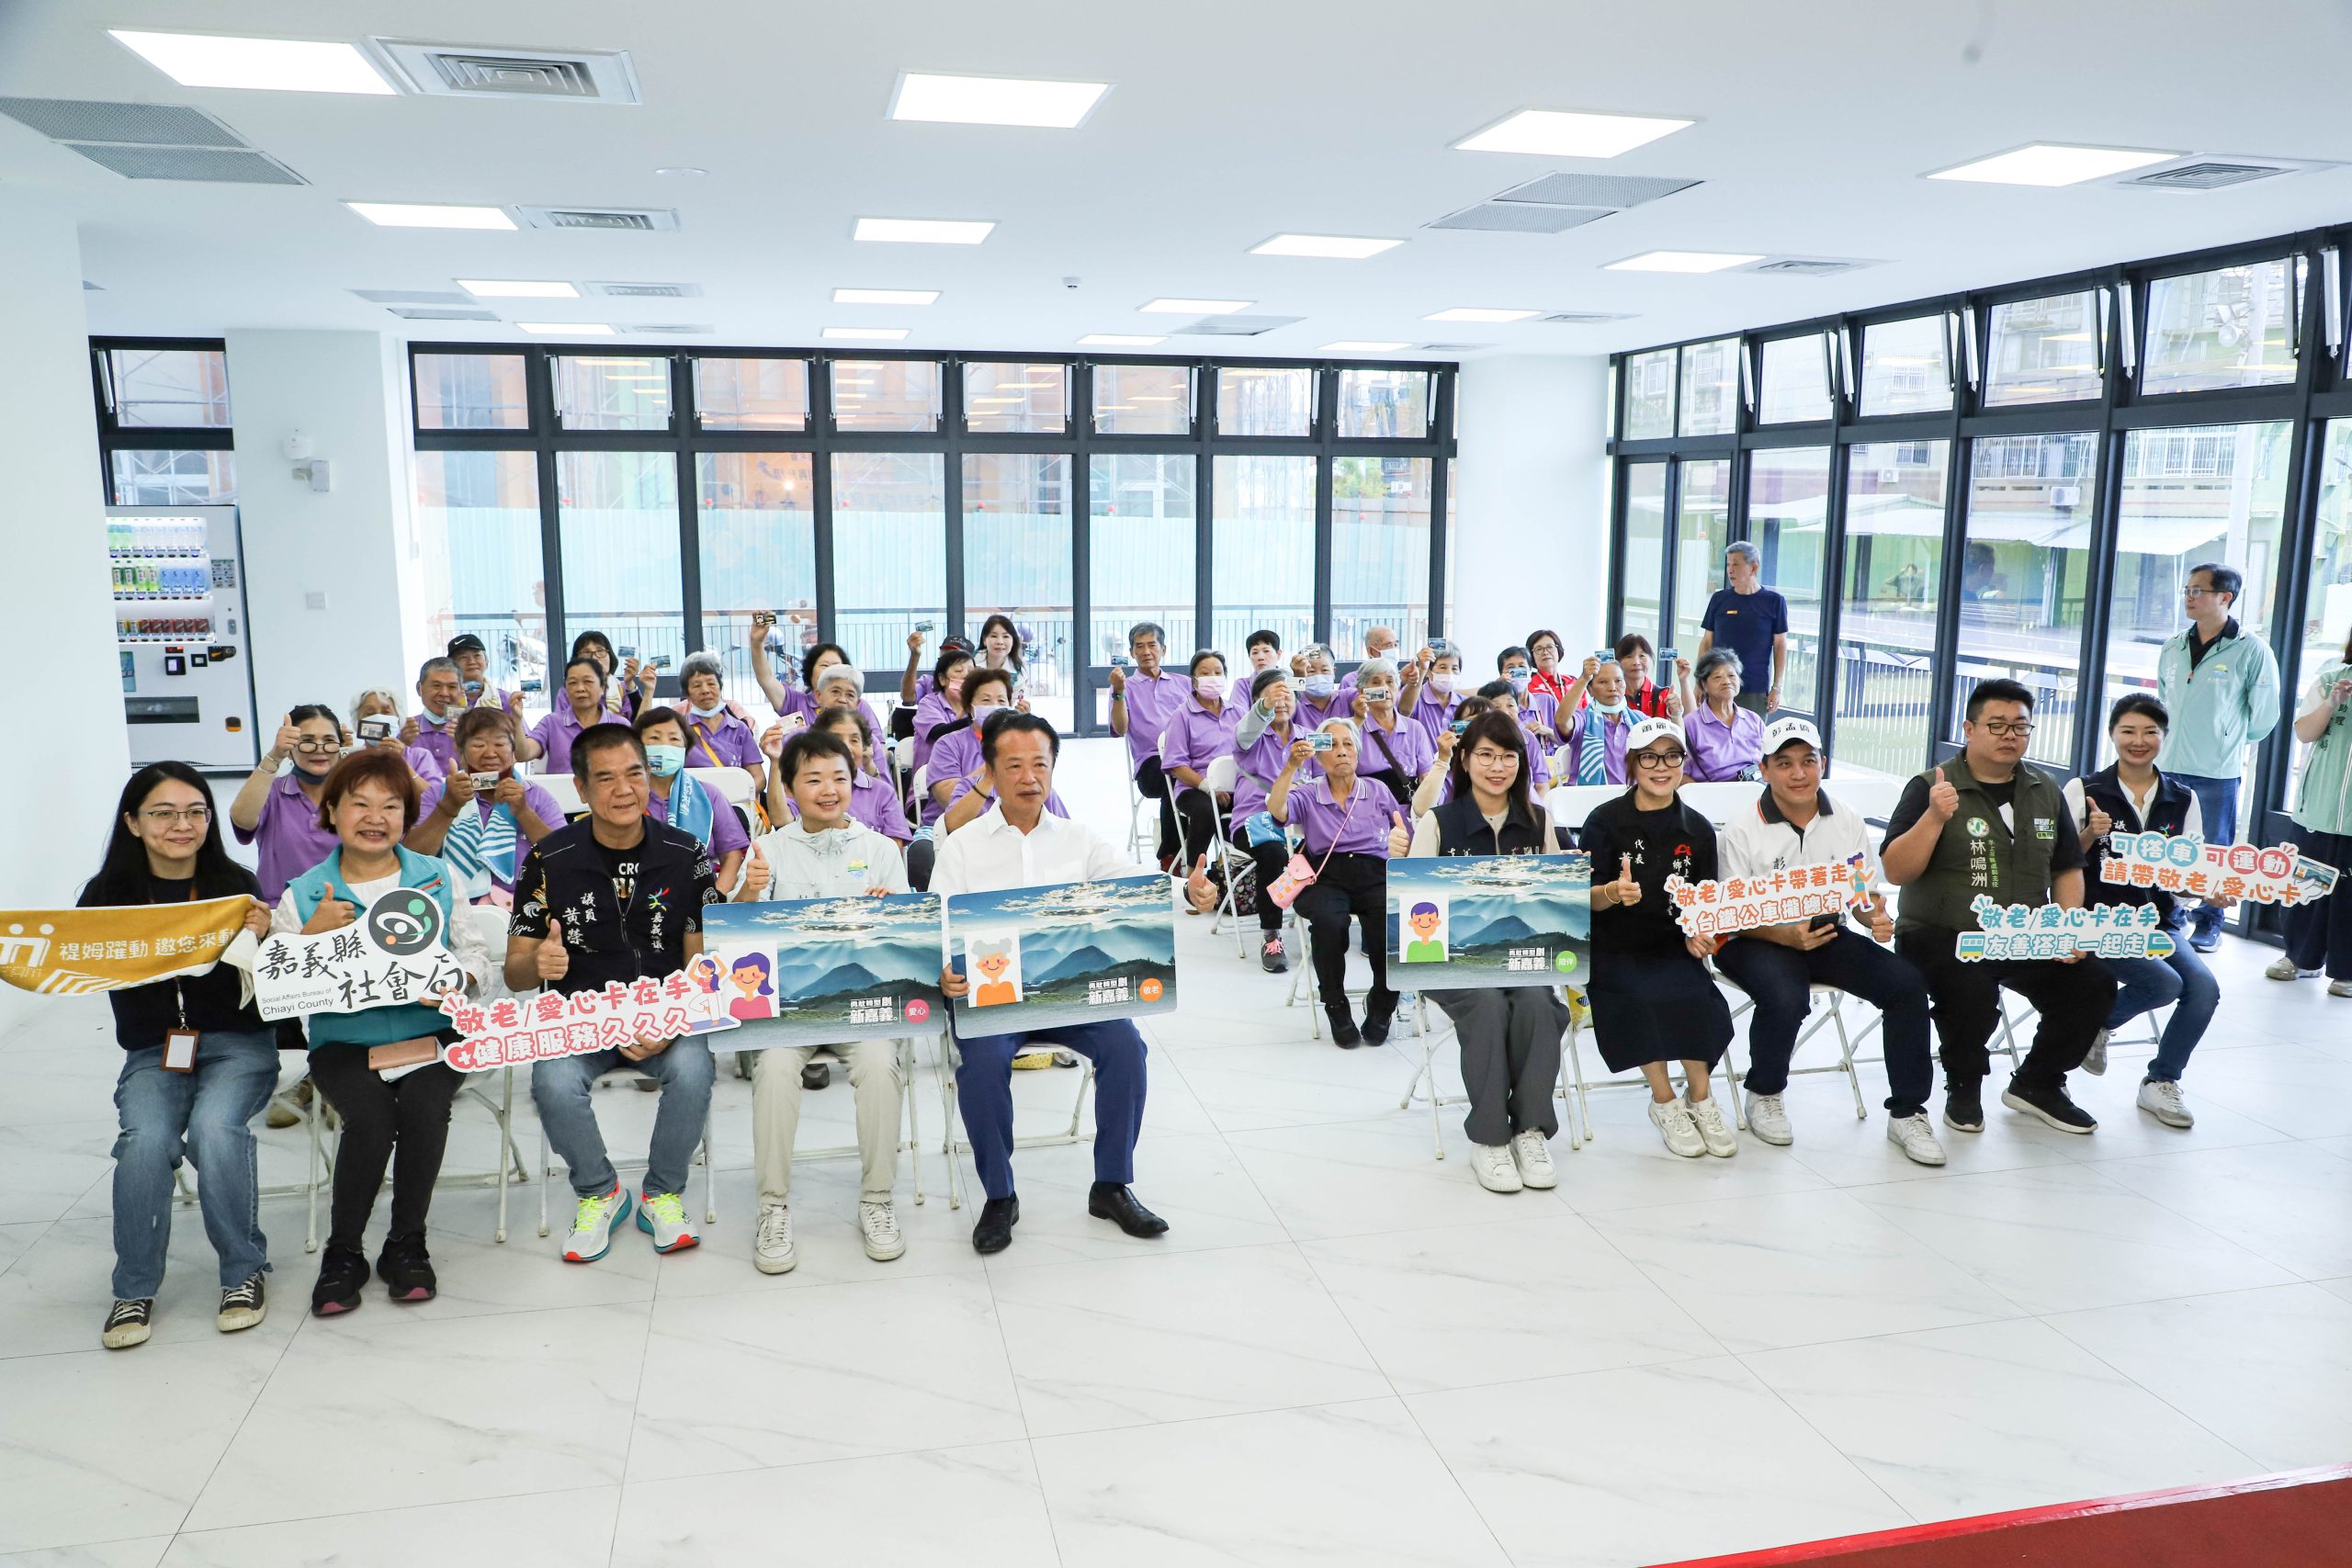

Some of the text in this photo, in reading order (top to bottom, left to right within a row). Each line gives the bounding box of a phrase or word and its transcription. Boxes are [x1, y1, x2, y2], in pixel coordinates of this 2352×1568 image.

[1634, 839, 1645, 864] 代表
[1970, 839, 1987, 887] 林鳴洲
[2113, 833, 2288, 875] 可搭車 可運動
[1676, 863, 1849, 908] 敬老/愛心卡帶著走
[2103, 861, 2301, 905] 請帶敬老/愛心卡
[581, 892, 597, 922] 議員
[1697, 890, 1842, 933] 台鐵公車攏總有
[1981, 906, 2158, 930] 敬老/愛心卡在手
[257, 929, 368, 980] 嘉義縣
[1558, 957, 1574, 966] 陪伴
[1985, 932, 2145, 957] 友善搭車一起走
[262, 995, 281, 1004] Social
[282, 992, 301, 1001] Affairs
[302, 989, 324, 998] Bureau
[337, 953, 464, 1010] 社會局
[1143, 986, 1160, 995] 敬老
[263, 998, 334, 1016] Chiayi County
[456, 974, 692, 1034] 敬老/愛心卡在手
[909, 1007, 926, 1017] 愛心
[472, 1008, 693, 1066] 健康服務久久久
